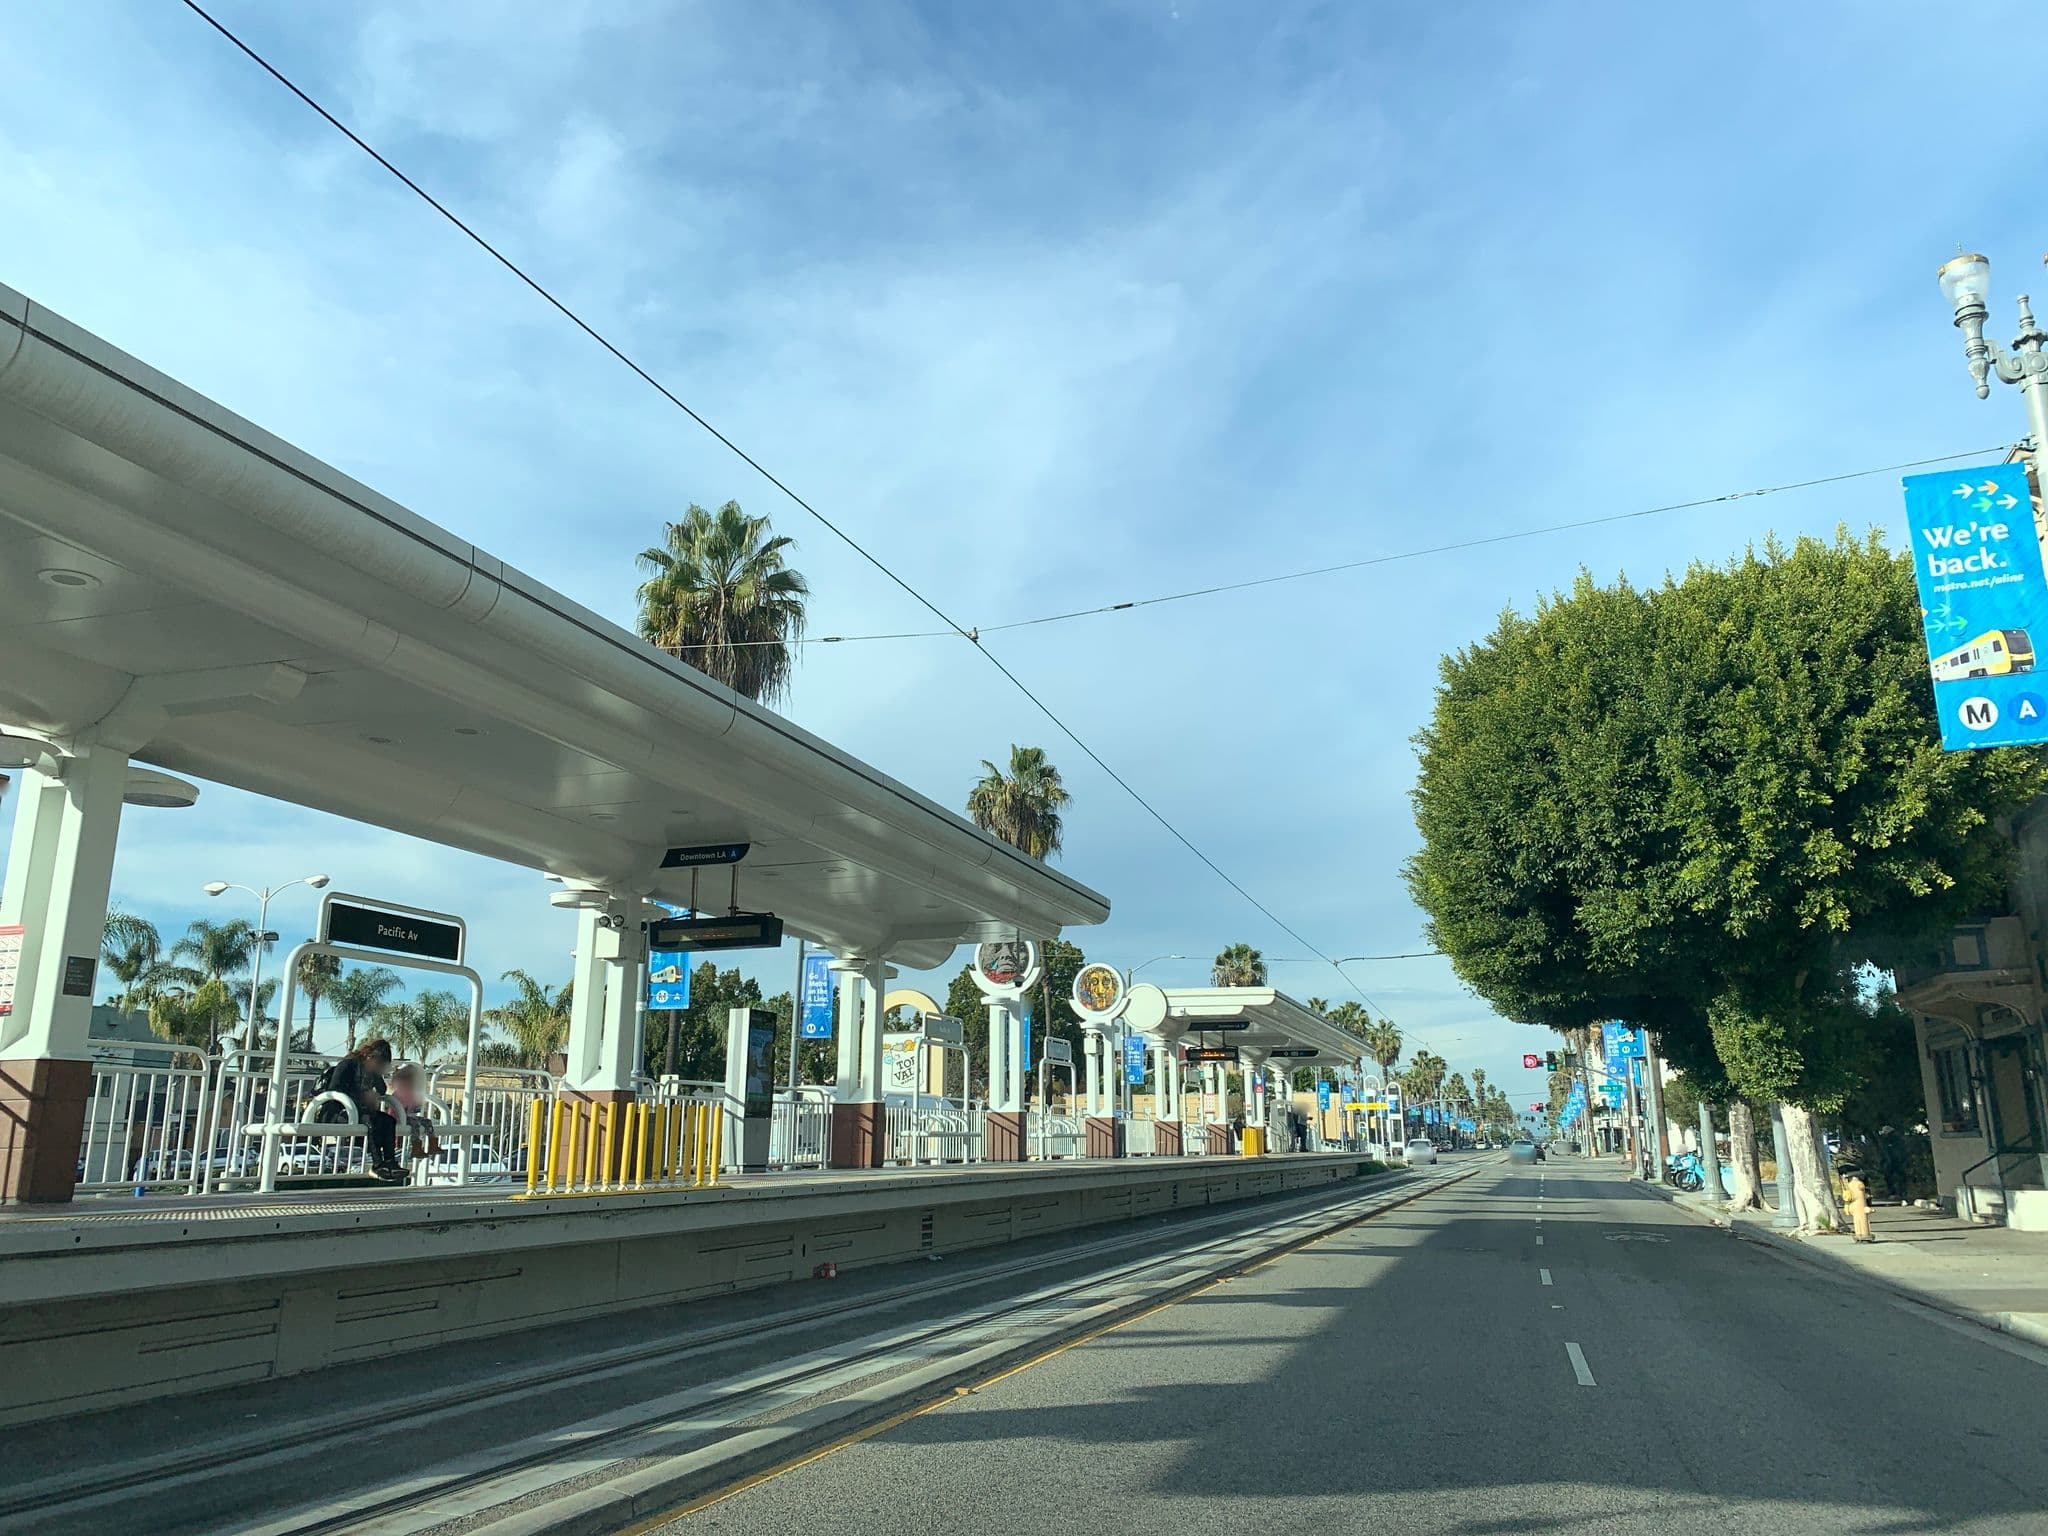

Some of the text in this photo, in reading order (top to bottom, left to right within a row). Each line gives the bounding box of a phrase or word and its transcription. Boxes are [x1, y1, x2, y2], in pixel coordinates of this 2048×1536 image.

[1922, 521, 2010, 549] We're
[1927, 546, 2008, 577] back.
[1966, 699, 2038, 725] M A
[680, 852, 716, 861] Downtown
[716, 851, 727, 859] LA
[377, 924, 418, 941] Pacific Av
